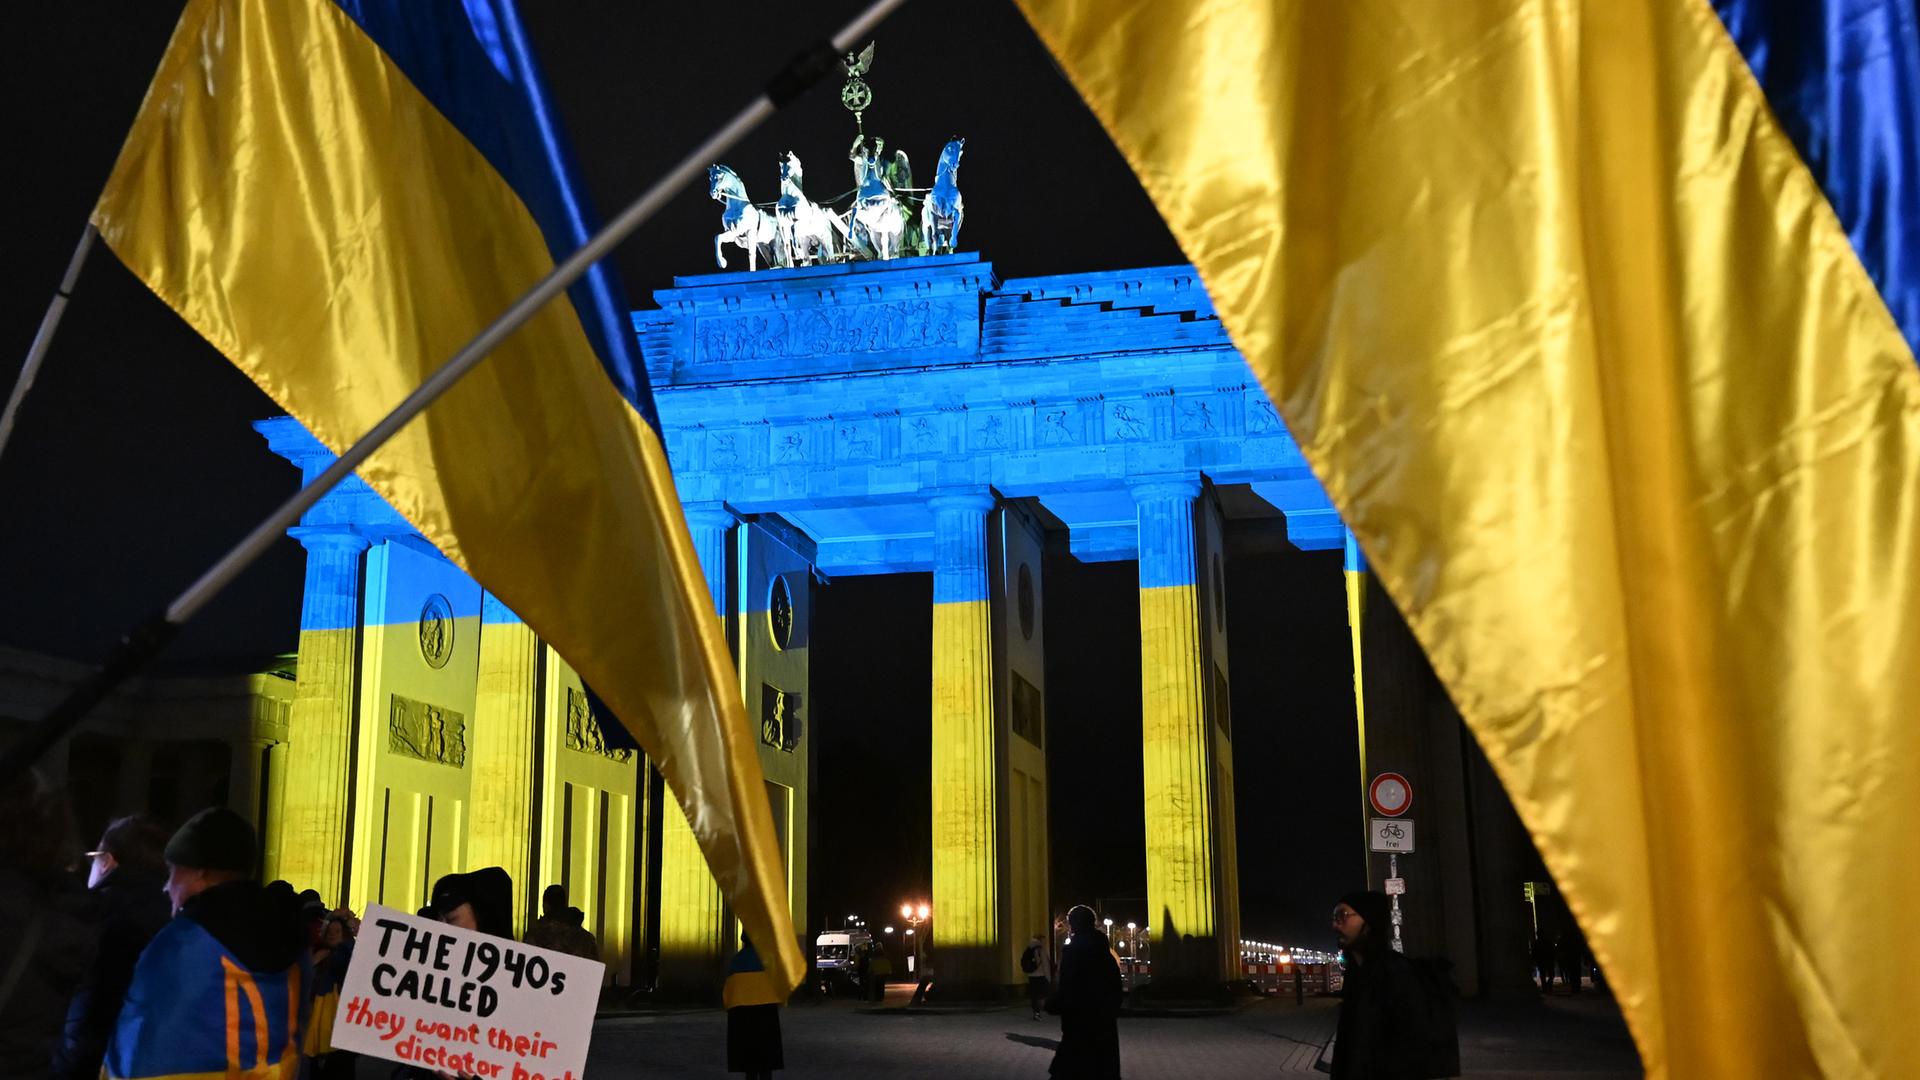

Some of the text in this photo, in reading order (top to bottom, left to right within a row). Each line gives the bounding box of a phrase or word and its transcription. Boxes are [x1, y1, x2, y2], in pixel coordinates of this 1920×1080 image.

[1385, 840, 1399, 848] frei
[376, 918, 566, 996] THE 1940s
[372, 963, 499, 1018] CALLED
[346, 996, 558, 1059] they want their
[395, 1035, 505, 1077] dictator
